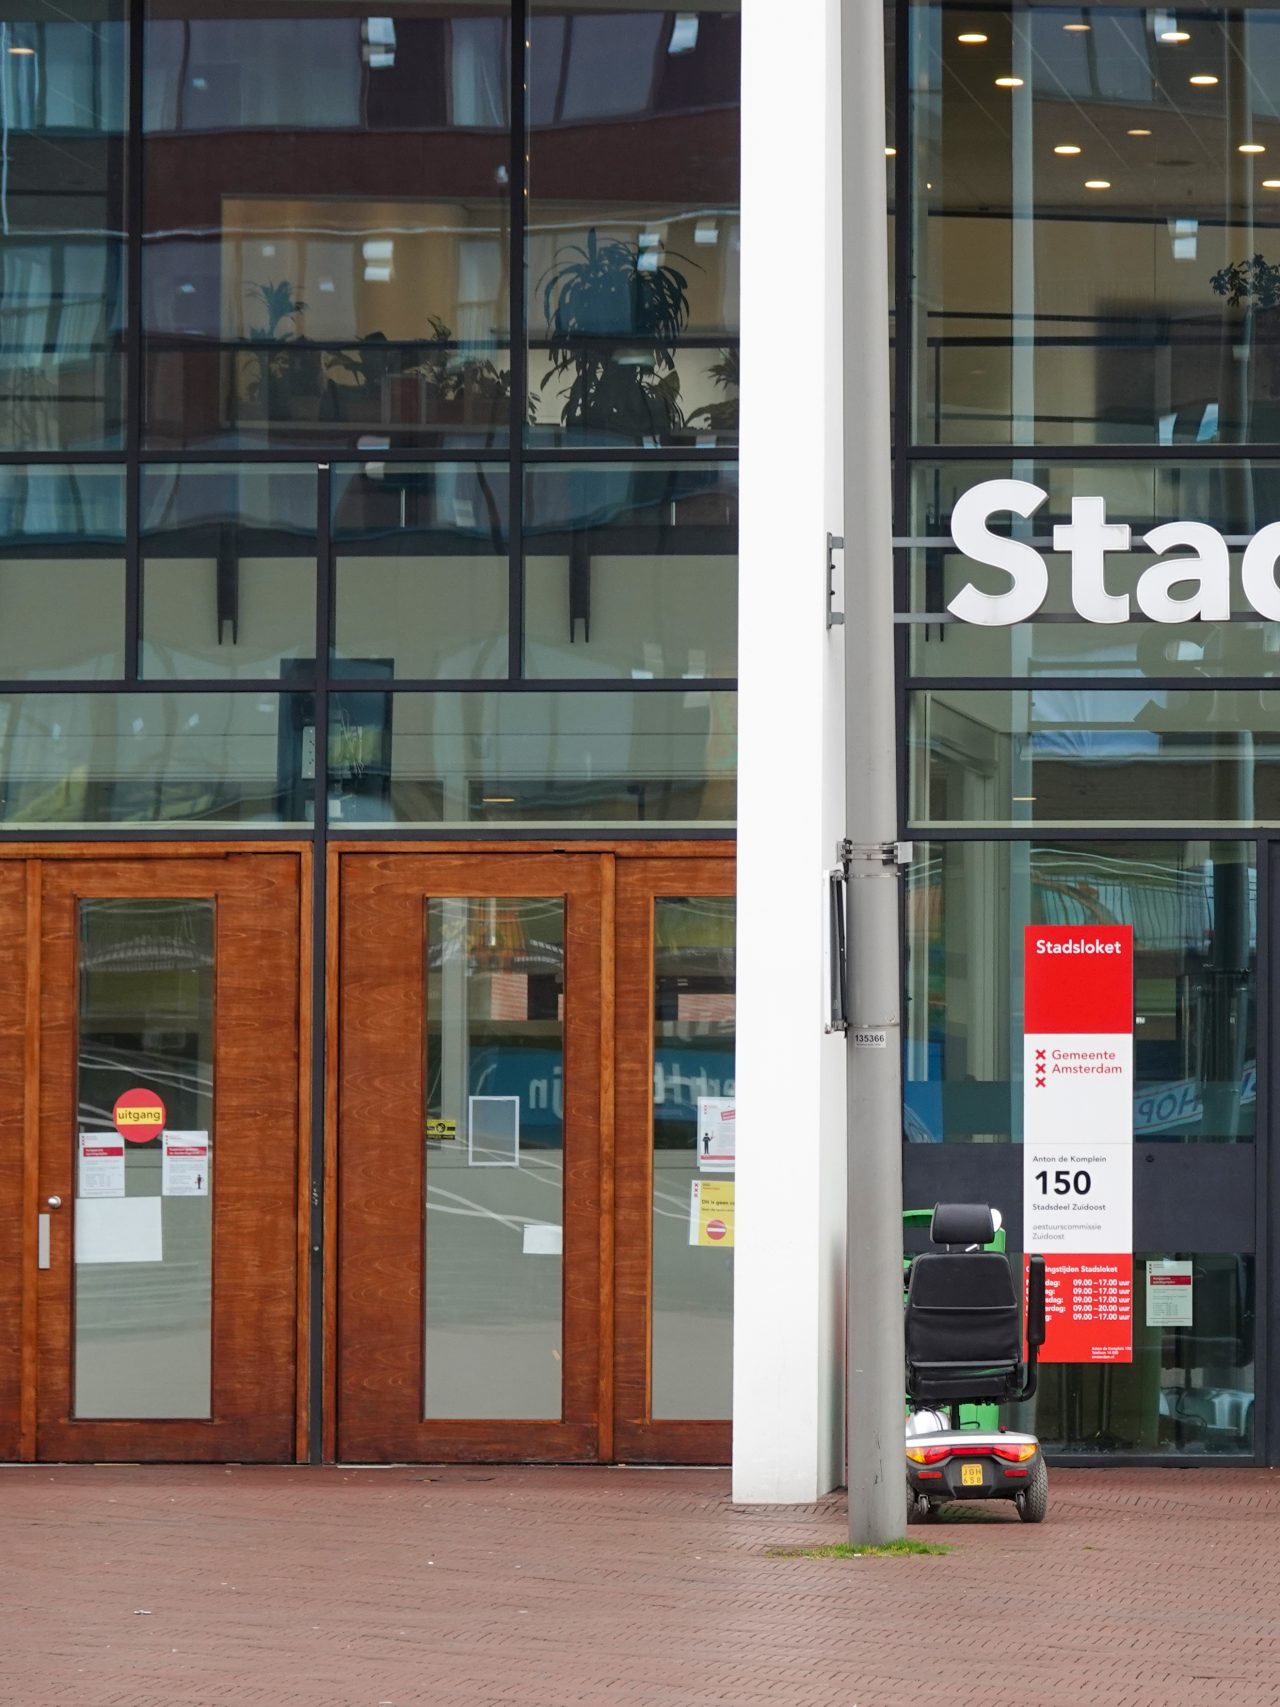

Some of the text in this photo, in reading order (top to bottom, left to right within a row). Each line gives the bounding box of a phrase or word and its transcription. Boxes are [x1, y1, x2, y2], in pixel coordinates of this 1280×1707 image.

[1035, 938, 1122, 955] Stadsloket
[855, 1034, 885, 1043] 135366
[1051, 1049, 1116, 1061] Gemeente
[1051, 1063, 1123, 1074] Amsterdam
[117, 1109, 161, 1122] uitgang
[1032, 1155, 1107, 1164] Anton de Komplein
[1034, 1170, 1092, 1195] 150
[1032, 1203, 1107, 1211] Stadsdeel Zuidoost
[1032, 1232, 1065, 1240] Zuidoost
[1080, 1265, 1118, 1273] Stadsloket
[963, 1468, 982, 1476] JGH
